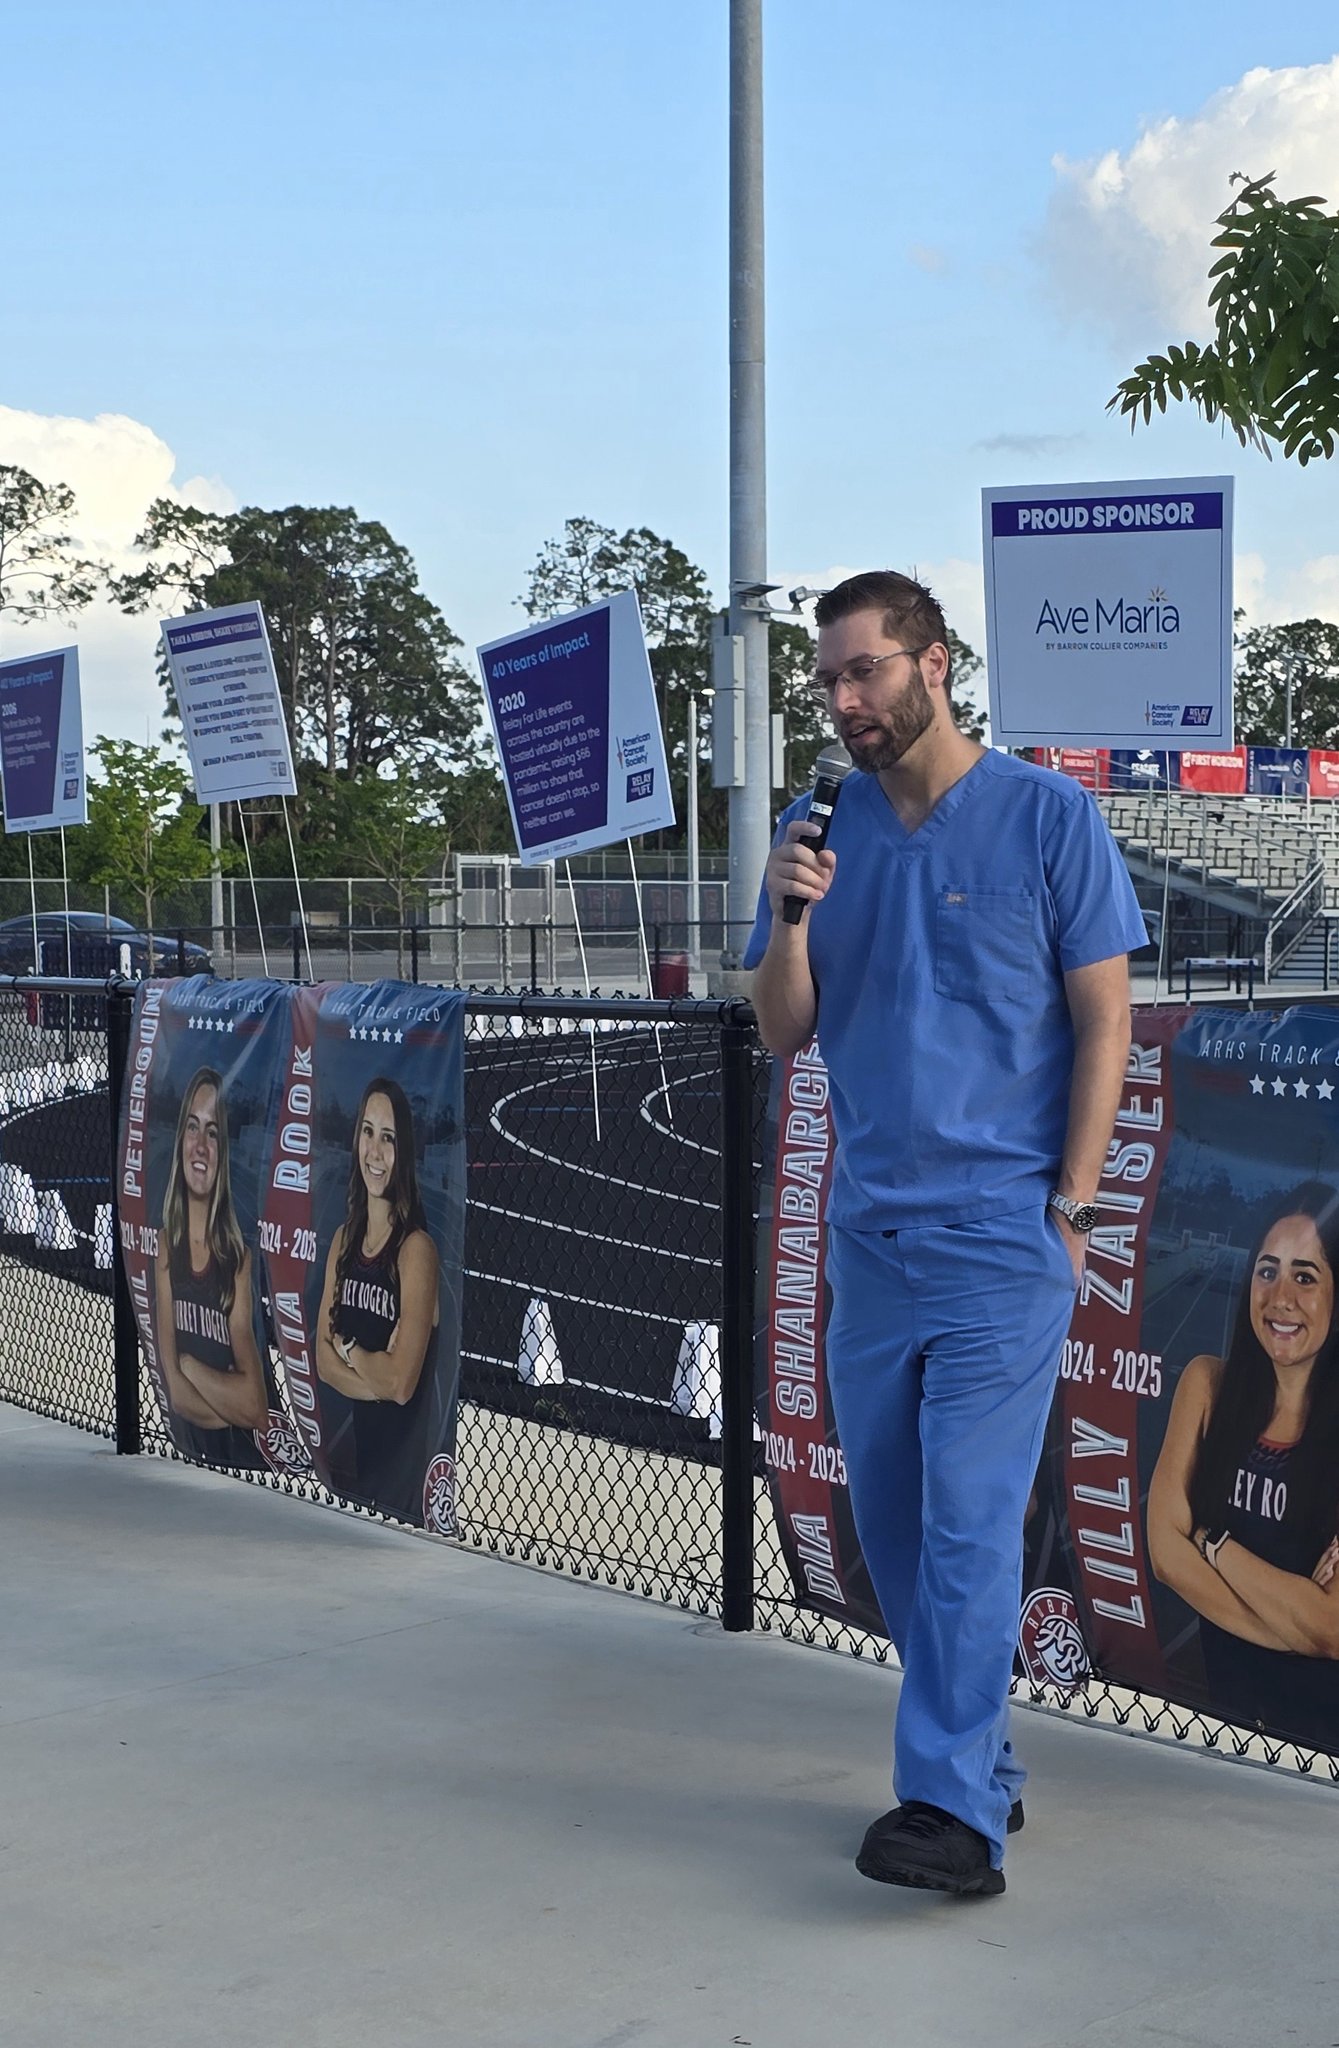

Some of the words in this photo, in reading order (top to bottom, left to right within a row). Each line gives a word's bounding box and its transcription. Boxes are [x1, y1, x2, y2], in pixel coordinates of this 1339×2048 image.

[1017, 505, 1089, 530] PROUD
[1092, 502, 1195, 528] SPONSOR
[1036, 598, 1089, 634] Ave
[1096, 597, 1180, 634] Maria
[492, 662, 506, 678] 40
[505, 653, 538, 674] Years
[538, 645, 550, 663] of
[550, 632, 590, 658] Impact
[1046, 642, 1055, 650] BY
[1057, 642, 1089, 650] BARRON
[1090, 642, 1121, 650] COLLIER
[1123, 641, 1168, 650] COMPANIES
[498, 691, 525, 714] 2020
[522, 713, 535, 724] For
[535, 707, 547, 720] Life
[548, 700, 573, 716] events
[506, 732, 531, 748] across
[531, 729, 543, 740] the
[544, 719, 571, 735] country
[572, 714, 585, 726] are
[509, 748, 534, 763] hosted
[535, 738, 562, 756] virtually
[563, 735, 578, 747] due
[578, 731, 587, 741] to
[587, 727, 600, 738] the
[622, 733, 651, 747] American
[551, 754, 576, 768] raising
[623, 745, 646, 758] Cancer
[625, 753, 648, 767] Society
[517, 782, 540, 797] million
[540, 780, 549, 789] to
[550, 774, 568, 787] show
[568, 768, 584, 780] that
[632, 772, 652, 786] RELAY
[520, 799, 545, 814] cancer
[591, 782, 600, 792] so
[523, 815, 547, 830] neither
[548, 811, 563, 822] can
[1201, 1039, 1246, 1060] ARHS
[1259, 1043, 1323, 1065] TRACK
[273, 1045, 313, 1194] ROOK
[1079, 1044, 1163, 1315] ZAISER
[775, 1034, 830, 1420] SHANABARGE
[290, 1227, 317, 1262] 2025
[358, 1282, 395, 1321] ROGERS
[275, 1292, 321, 1447] JULIA
[1061, 1339, 1095, 1384] 024
[1112, 1349, 1162, 1398] 2025
[762, 1430, 796, 1473] 2024
[808, 1442, 848, 1486] 2025
[1072, 1417, 1145, 1628] LILLY
[790, 1513, 847, 1605] DIA
[1027, 1598, 1079, 1630] AUBR
